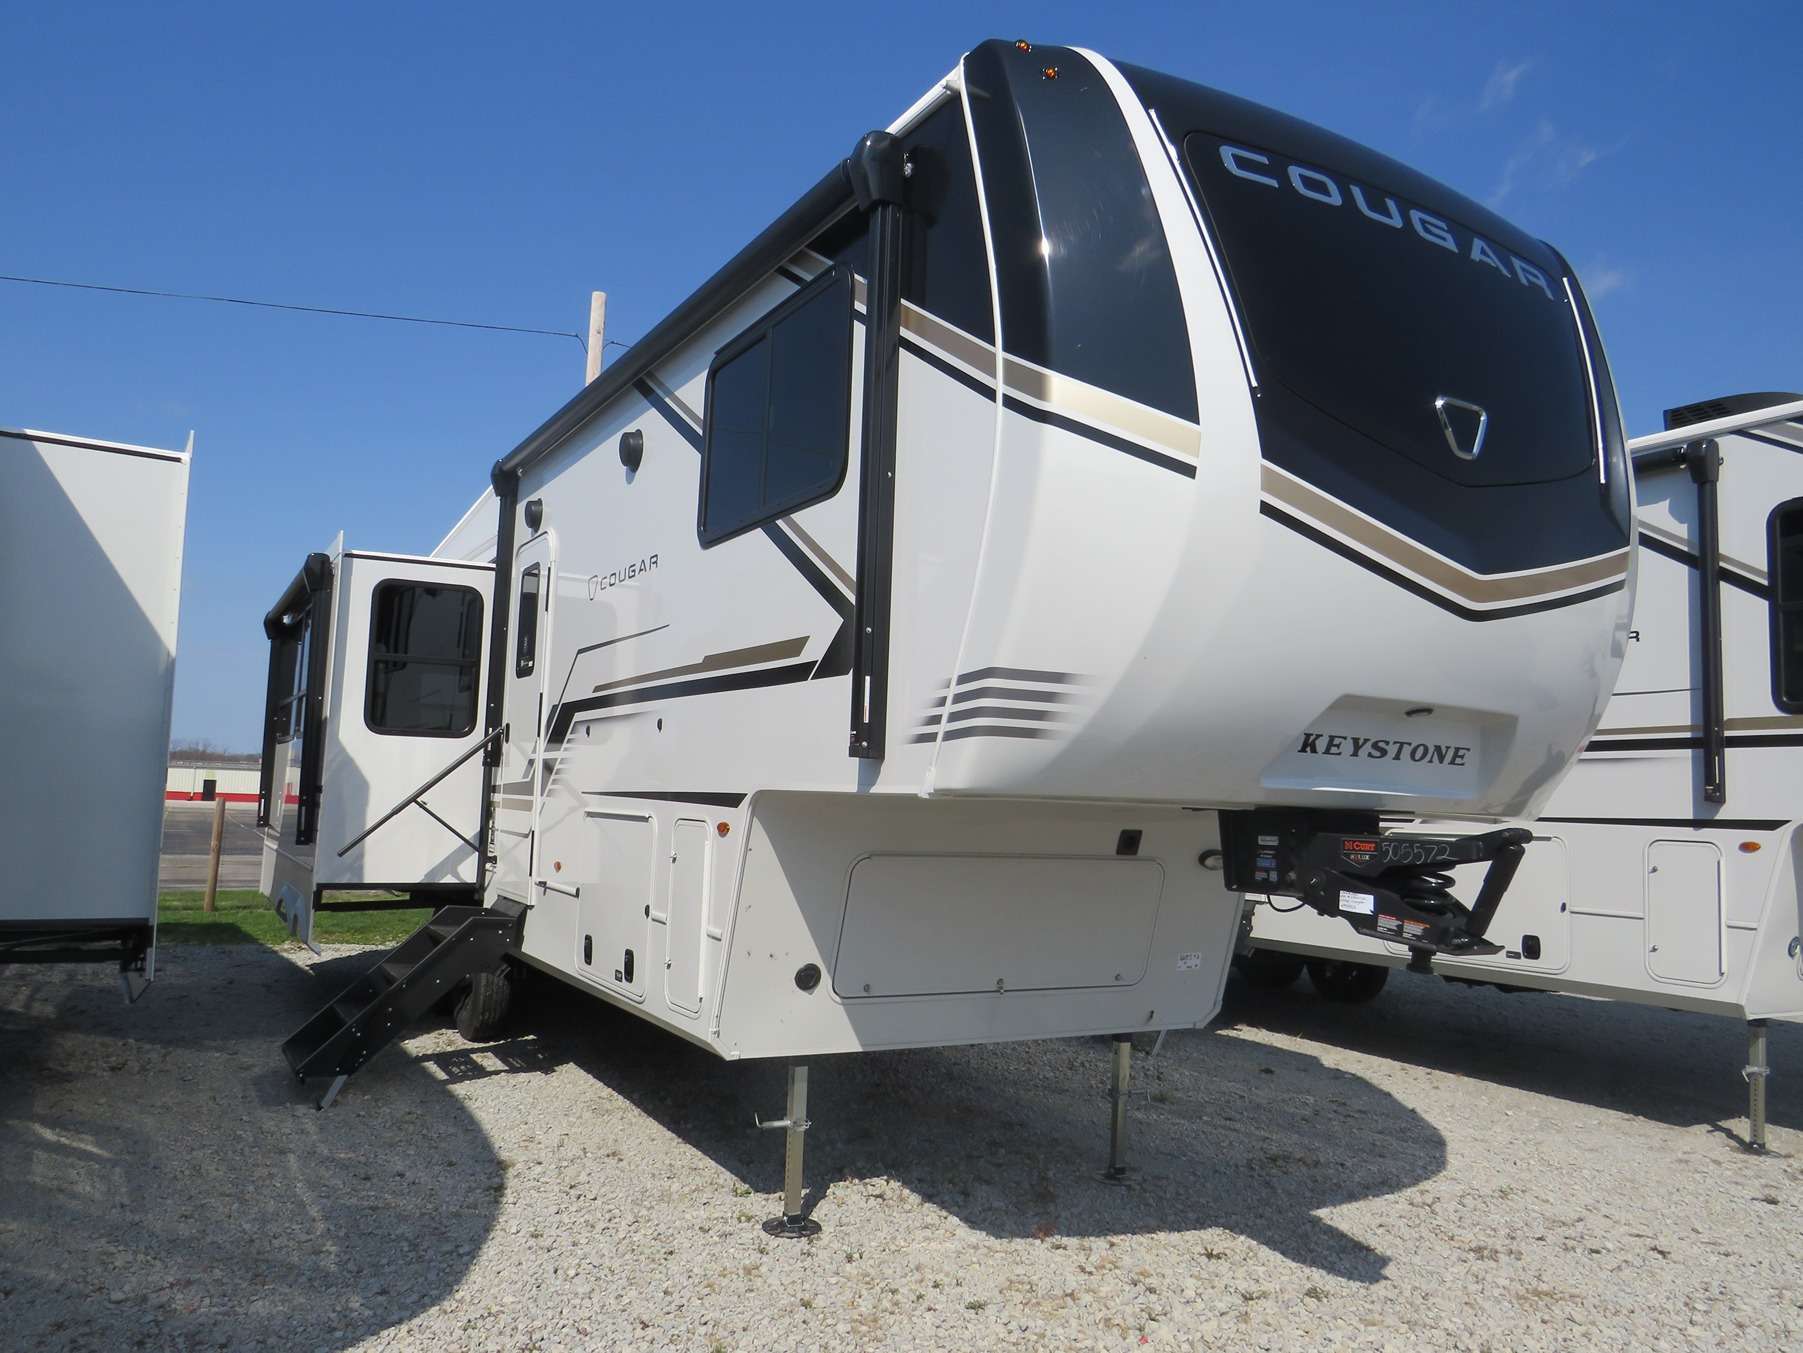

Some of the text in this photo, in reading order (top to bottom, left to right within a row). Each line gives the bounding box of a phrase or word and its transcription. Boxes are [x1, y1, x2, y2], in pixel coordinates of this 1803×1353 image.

[1219, 145, 1554, 300] COUGAR
[600, 553, 659, 591] COUGAR
[1297, 732, 1471, 766] KEYSTONE
